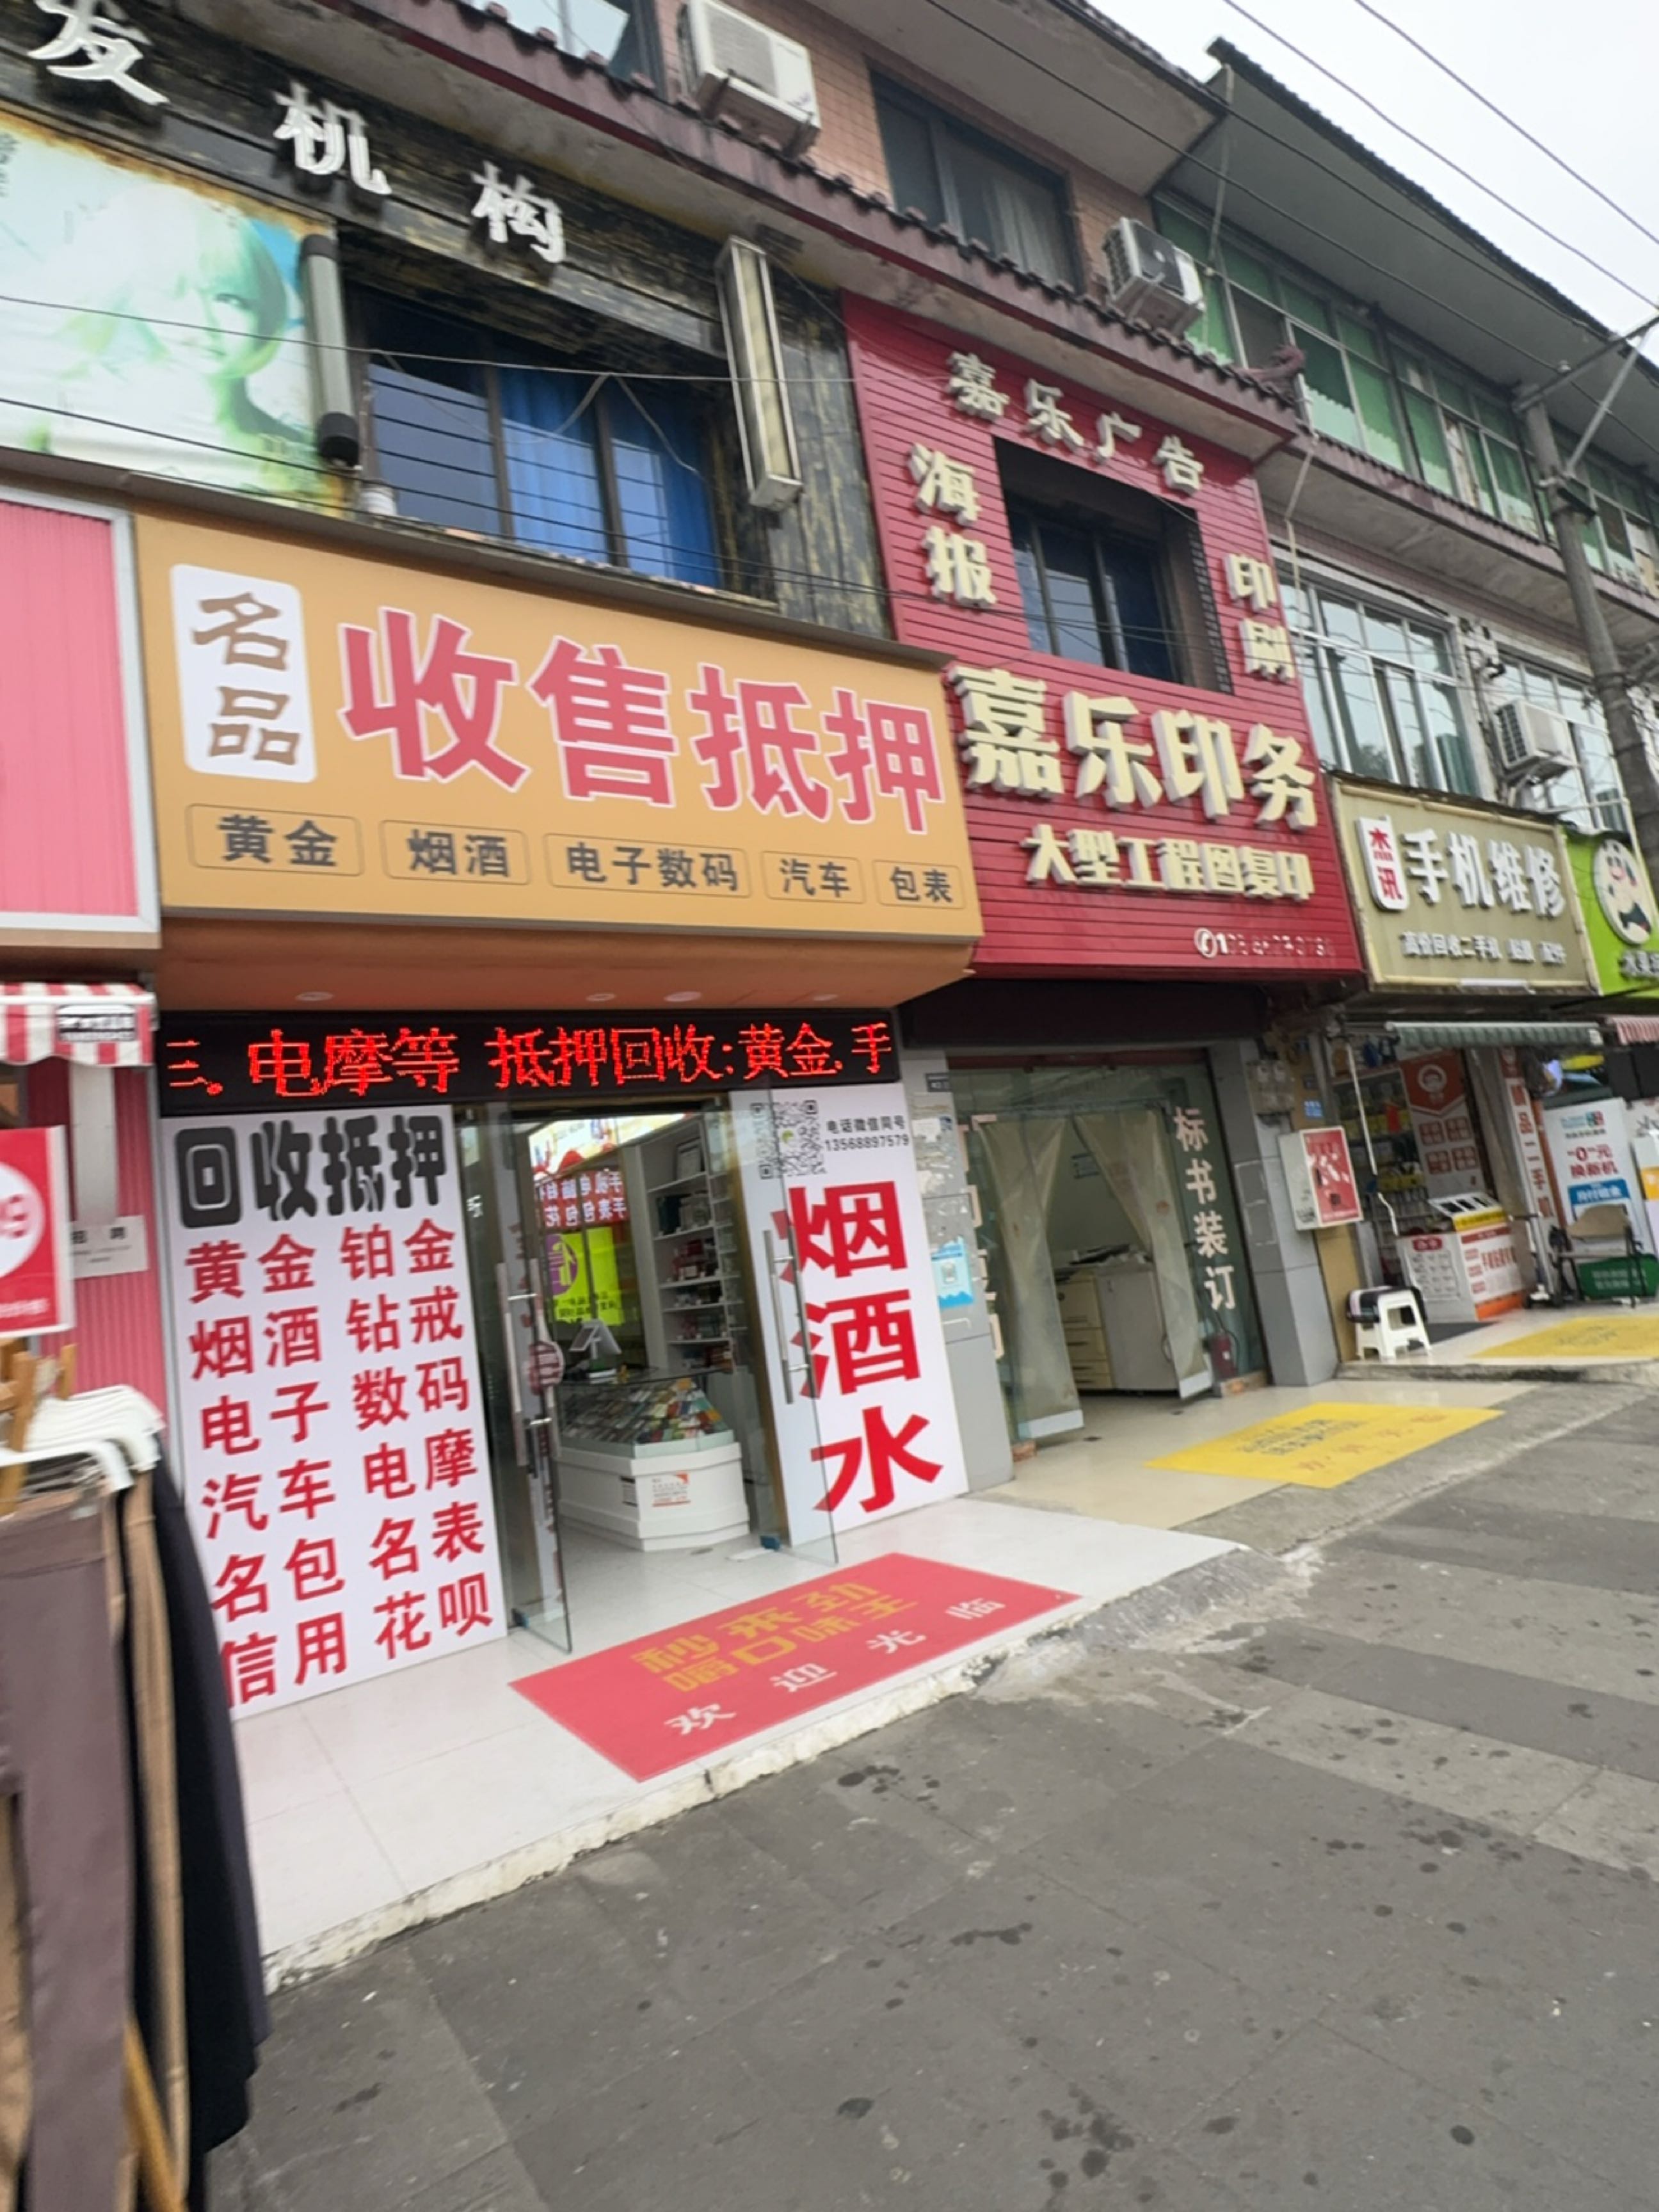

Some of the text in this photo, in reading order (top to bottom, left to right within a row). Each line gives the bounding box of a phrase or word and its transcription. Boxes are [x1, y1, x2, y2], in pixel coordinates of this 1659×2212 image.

[946, 351, 1204, 496] 嘉乐广告
[908, 443, 997, 608] 海报
[193, 592, 301, 765] 名品
[1226, 553, 1295, 684] 印刷
[338, 606, 945, 835] 收售抵押
[948, 665, 1317, 831] 嘉乐印务
[217, 814, 953, 904] 黄金 烟酒 电子数码 汽车 包表
[1020, 823, 1314, 902] 大型工程图复印
[1401, 829, 1566, 917] 手机维修
[175, 1114, 447, 1229] 回收抵押
[1174, 1107, 1236, 1310] 标书装订
[185, 1217, 456, 1304] 黄金 铂金
[189, 1285, 464, 1380] 烟酒 钻戒
[772, 1180, 943, 1513] 烟酒水
[200, 1356, 469, 1455] 电子 数码
[200, 1427, 477, 1540] 汽车 电摩
[211, 1501, 486, 1623] 名包 名表
[221, 1572, 493, 1709] 信用 花呗
[630, 1582, 879, 1673] 秒来劲
[665, 1597, 1005, 1735] 欢迎光临
